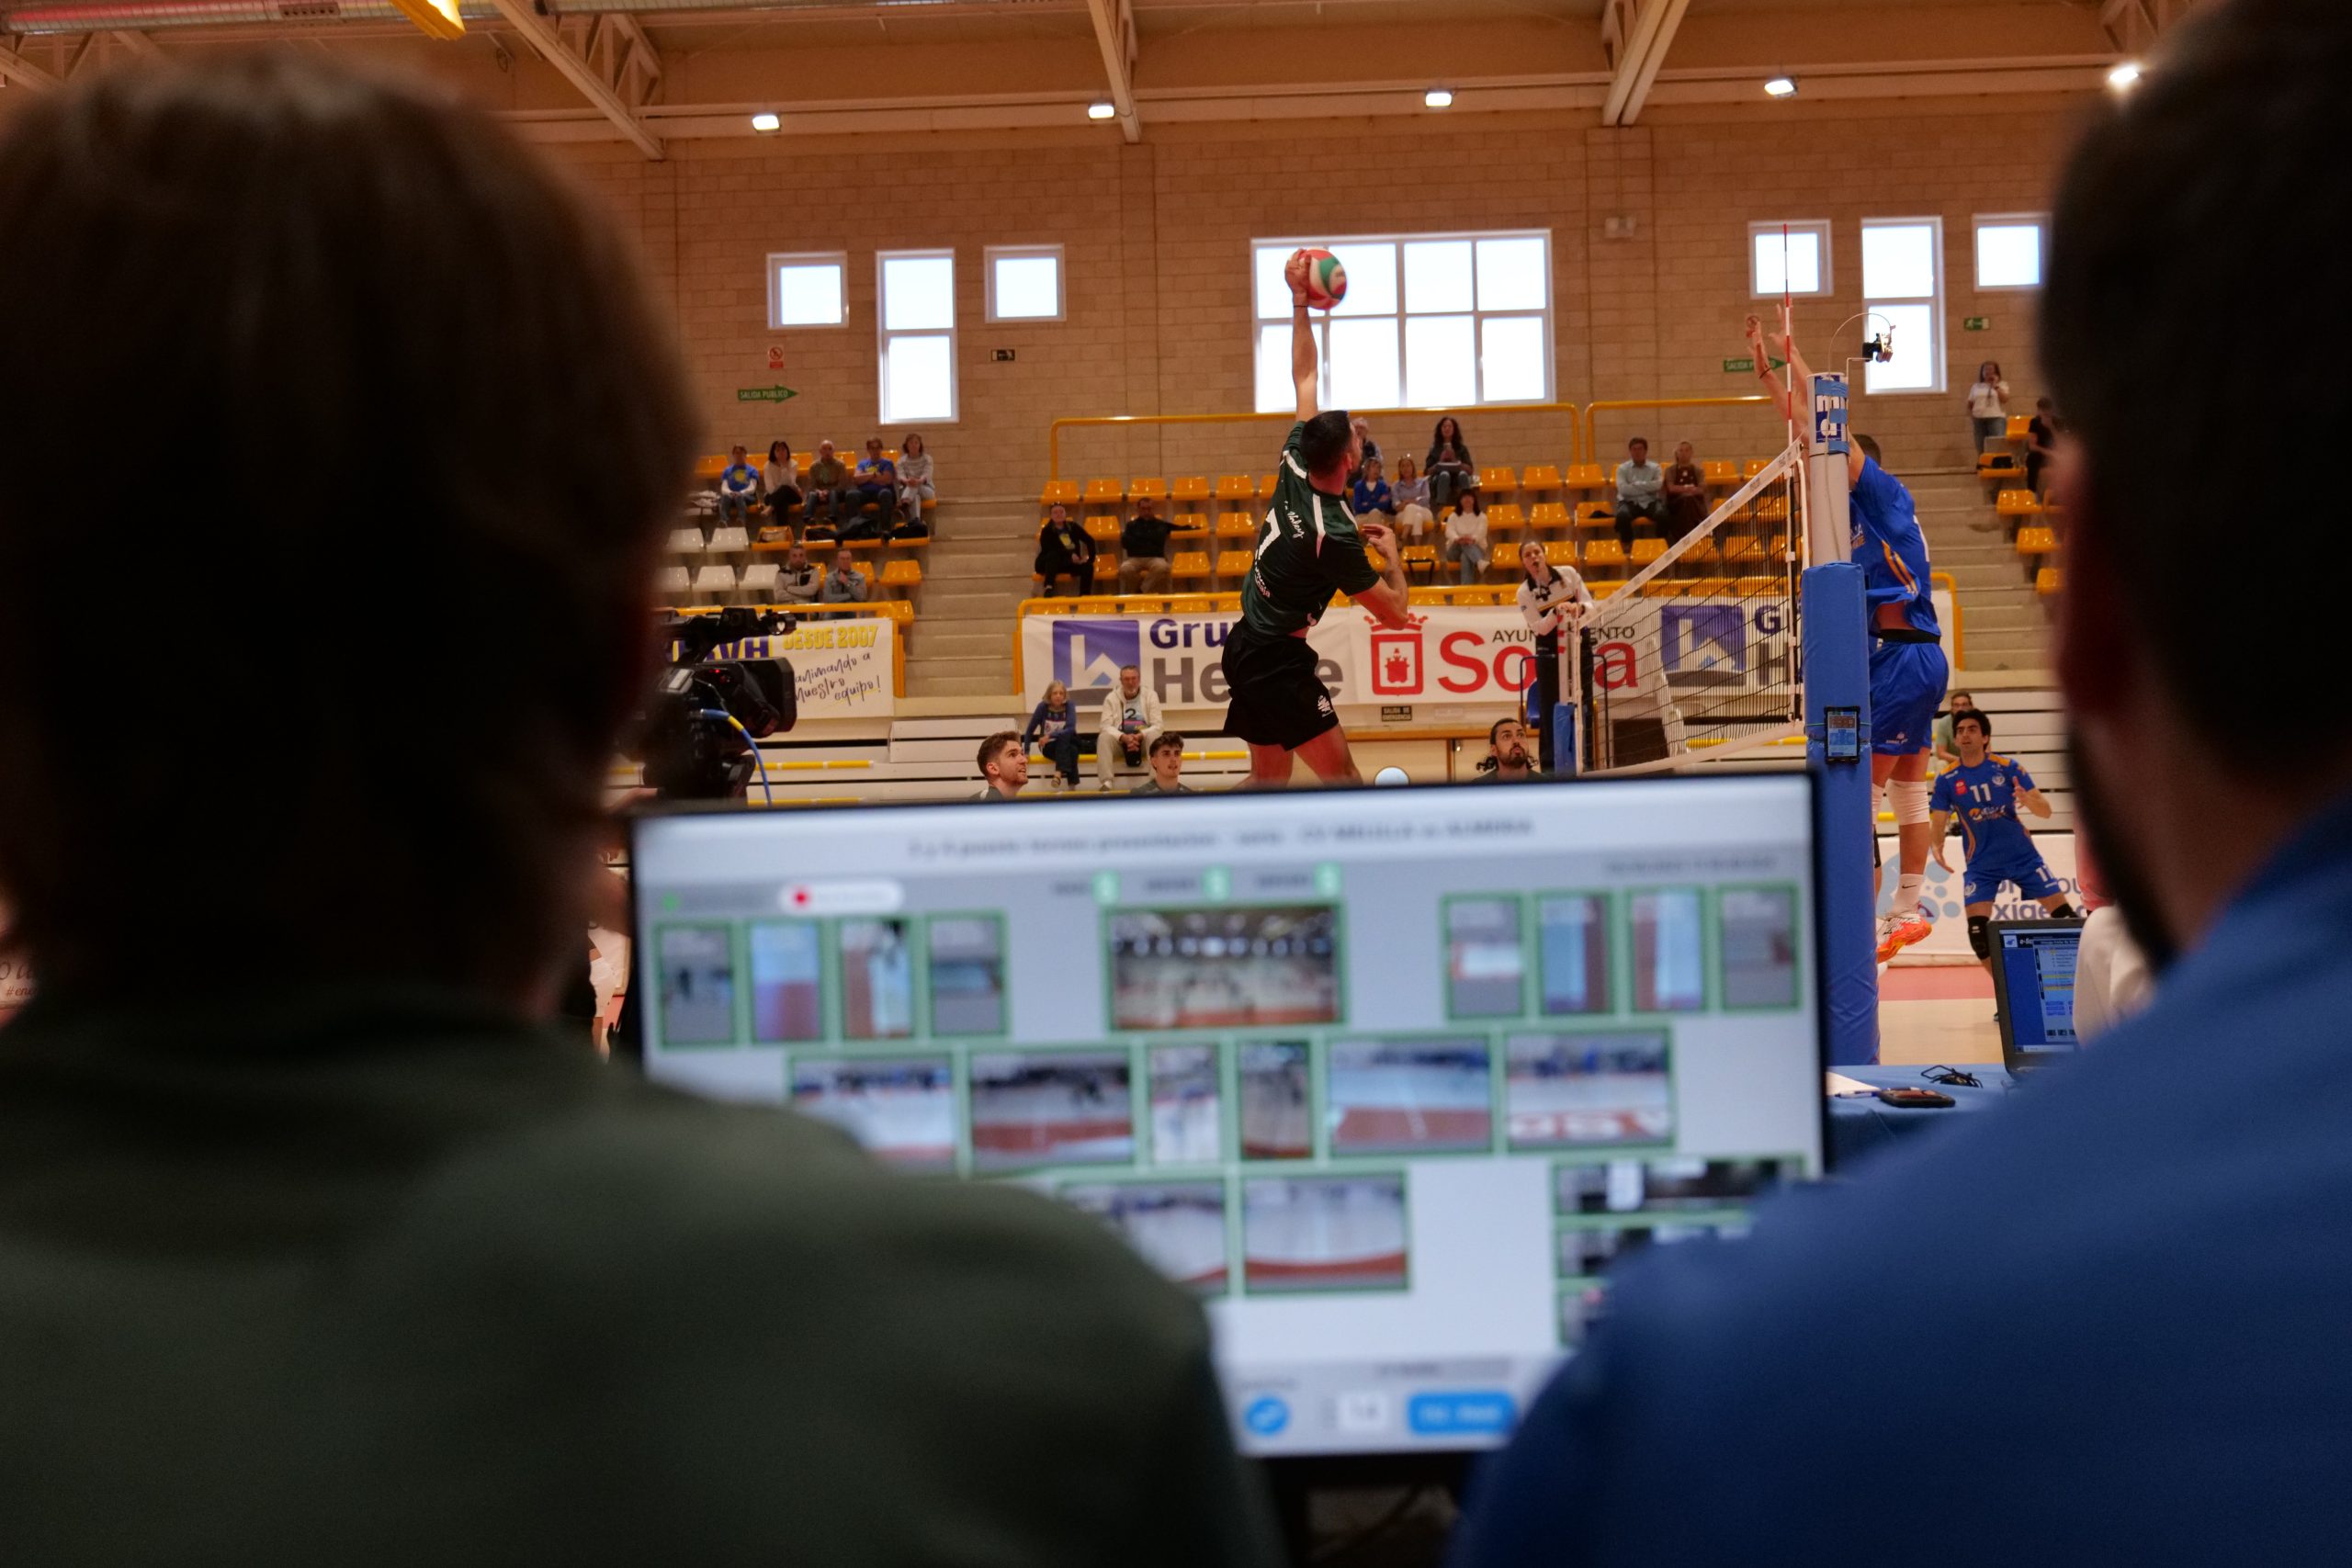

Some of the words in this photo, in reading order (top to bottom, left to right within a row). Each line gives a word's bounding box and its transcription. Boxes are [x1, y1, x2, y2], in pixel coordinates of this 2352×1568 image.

[785, 627, 834, 650] DESDE
[837, 626, 879, 649] 2007
[1149, 618, 1238, 649] Gru
[863, 652, 871, 661] a
[1437, 631, 1638, 694] Soa
[834, 675, 881, 706] equipo!
[1153, 657, 1343, 704] Hee
[1125, 708, 1136, 720] 2
[1970, 784, 1992, 803] 11
